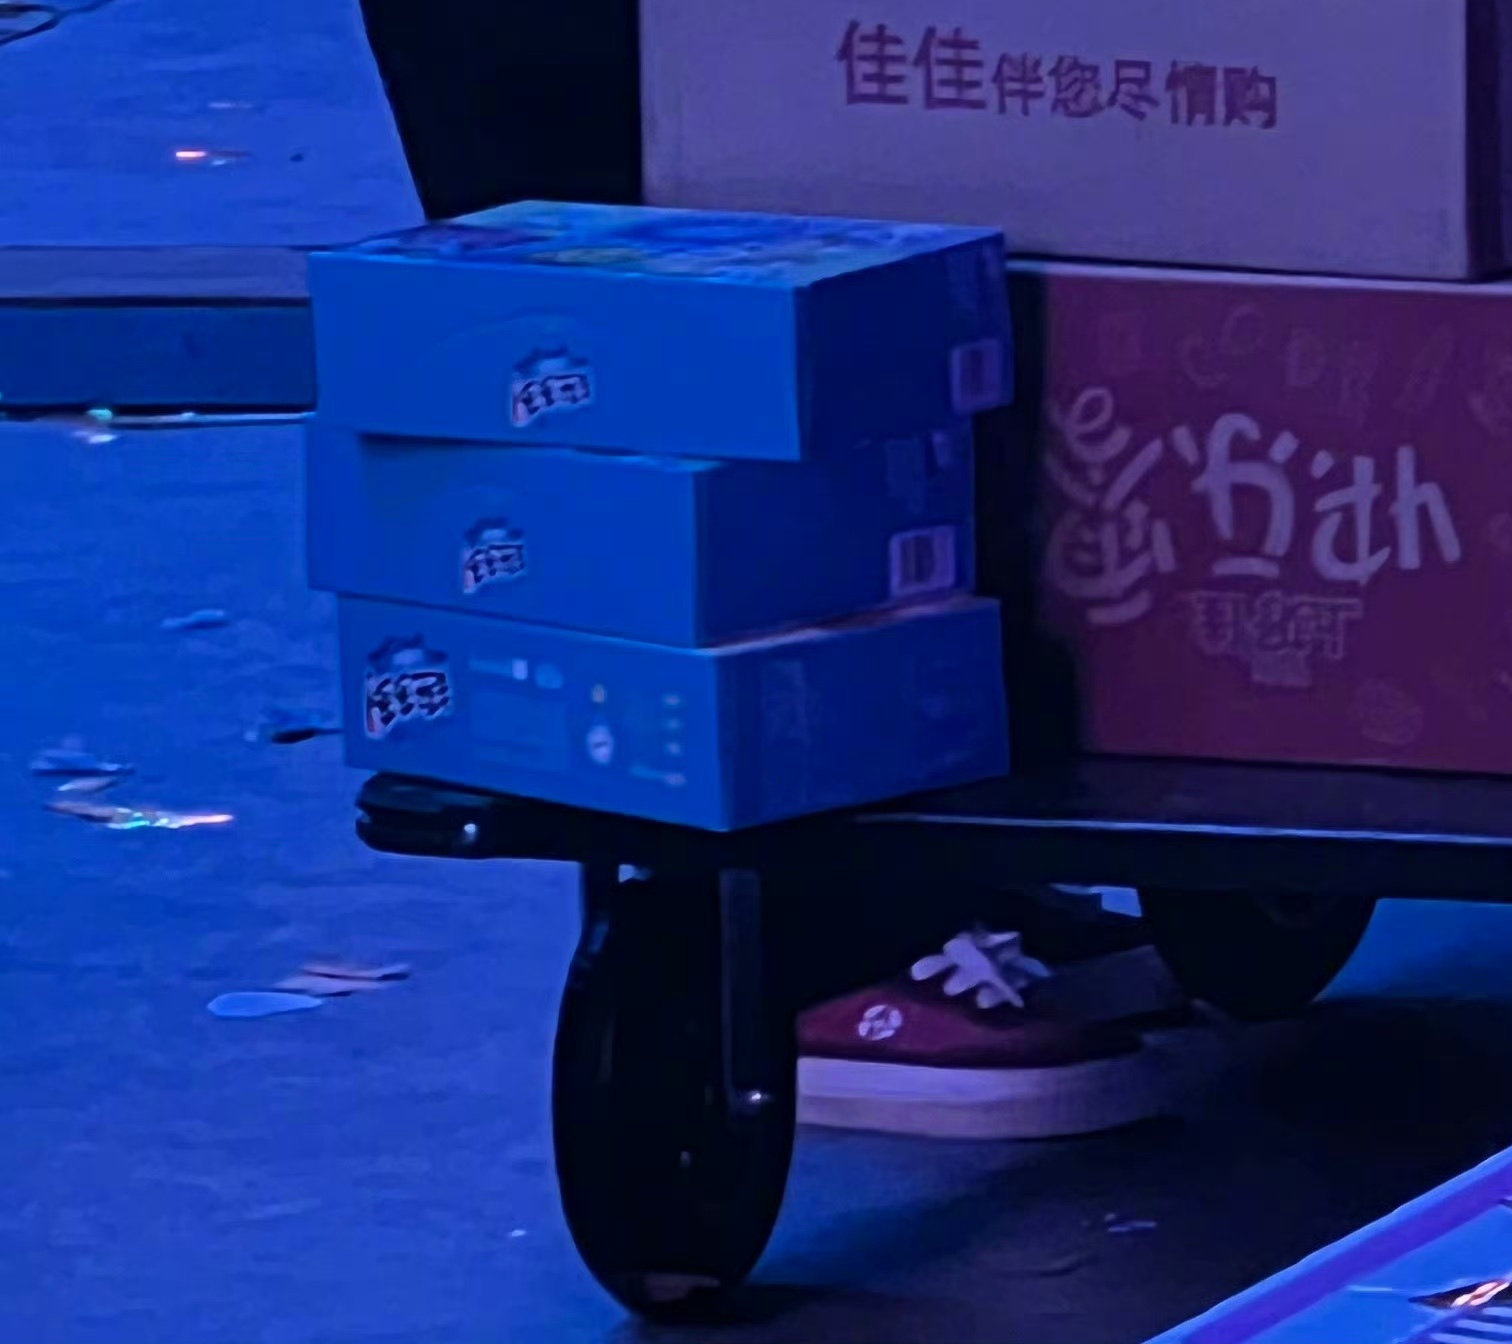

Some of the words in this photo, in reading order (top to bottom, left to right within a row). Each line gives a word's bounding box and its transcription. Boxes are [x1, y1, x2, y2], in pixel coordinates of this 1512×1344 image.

[835, 18, 1279, 130] 佳佳伴您尽情购
